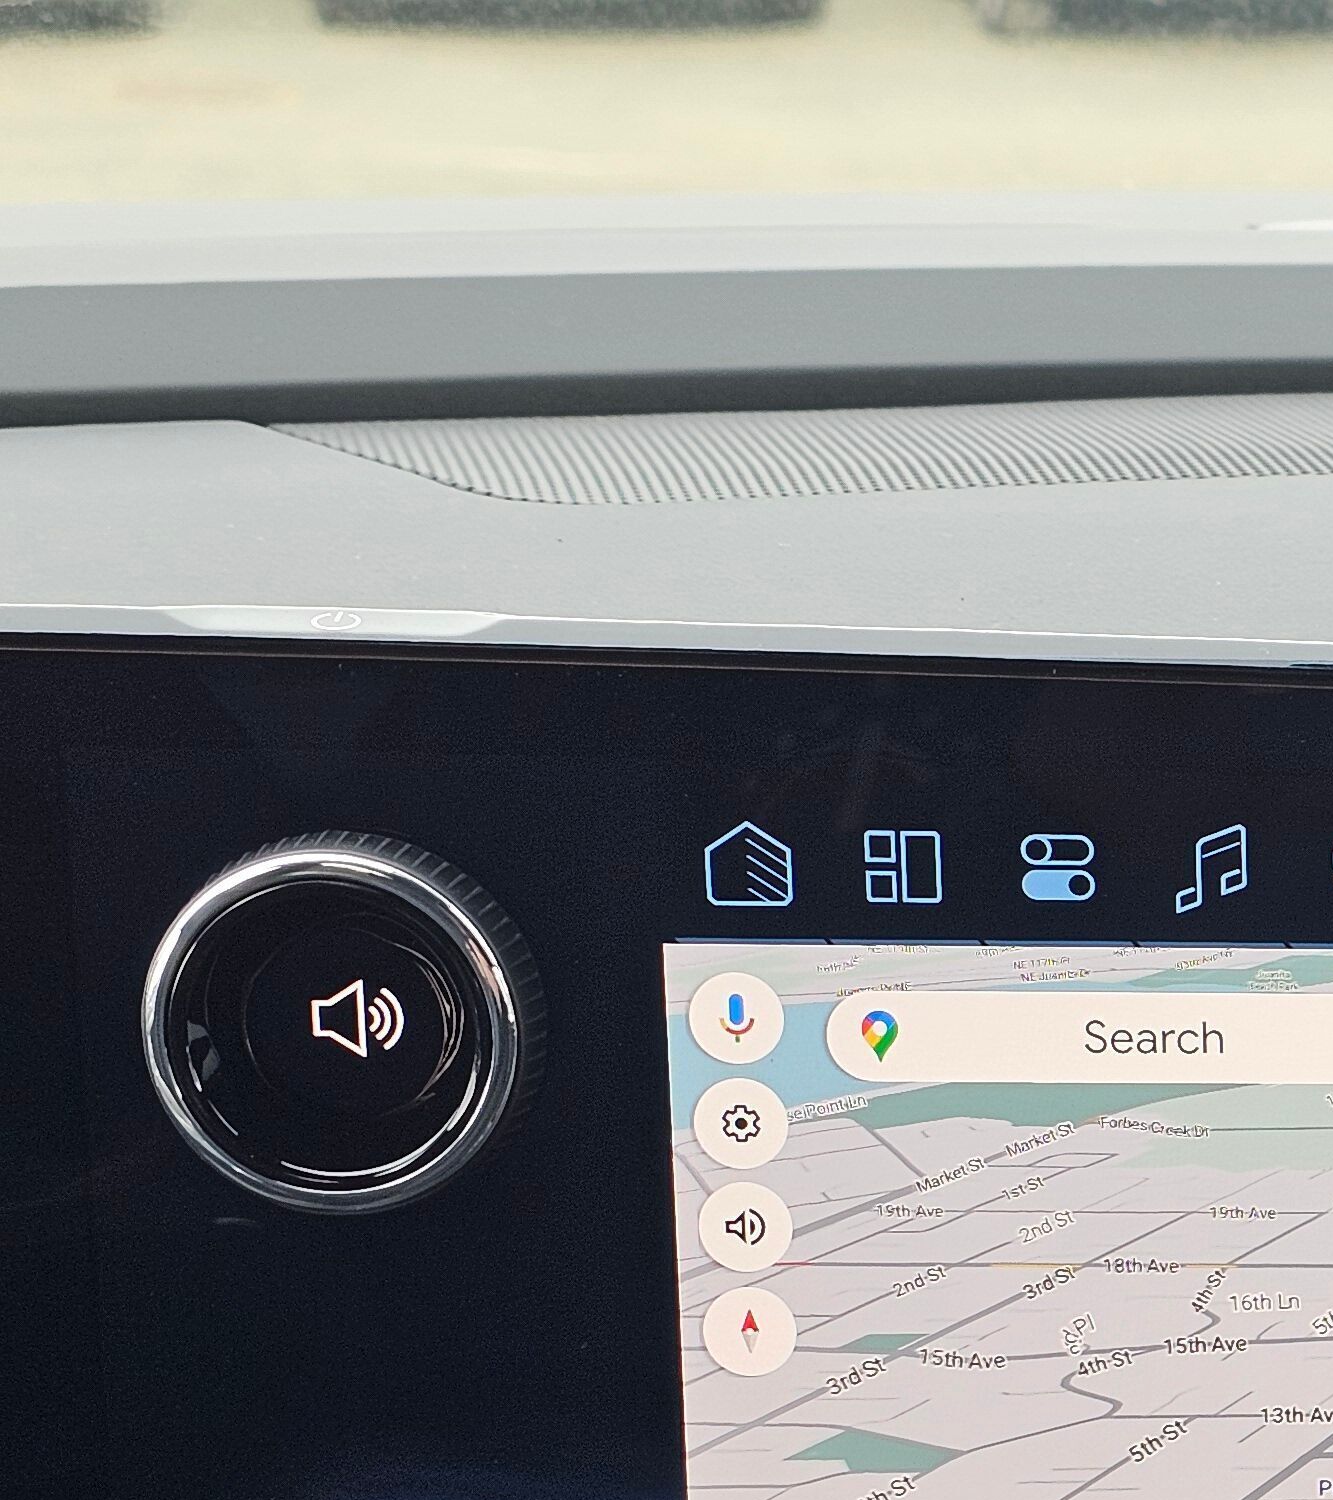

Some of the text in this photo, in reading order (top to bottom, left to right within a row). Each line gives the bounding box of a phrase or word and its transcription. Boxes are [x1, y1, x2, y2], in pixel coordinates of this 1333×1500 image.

[1085, 1021, 1224, 1054] Search
[915, 1158, 986, 1192] Market St
[1104, 1259, 1180, 1273] 18th Ave
[1164, 1337, 1247, 1353] 15th Ave
[920, 1351, 1006, 1369] 15th Ave
[1261, 1408, 1303, 1423] 13th
[1129, 1422, 1188, 1462] 5th St
[891, 1476, 915, 1499] St
